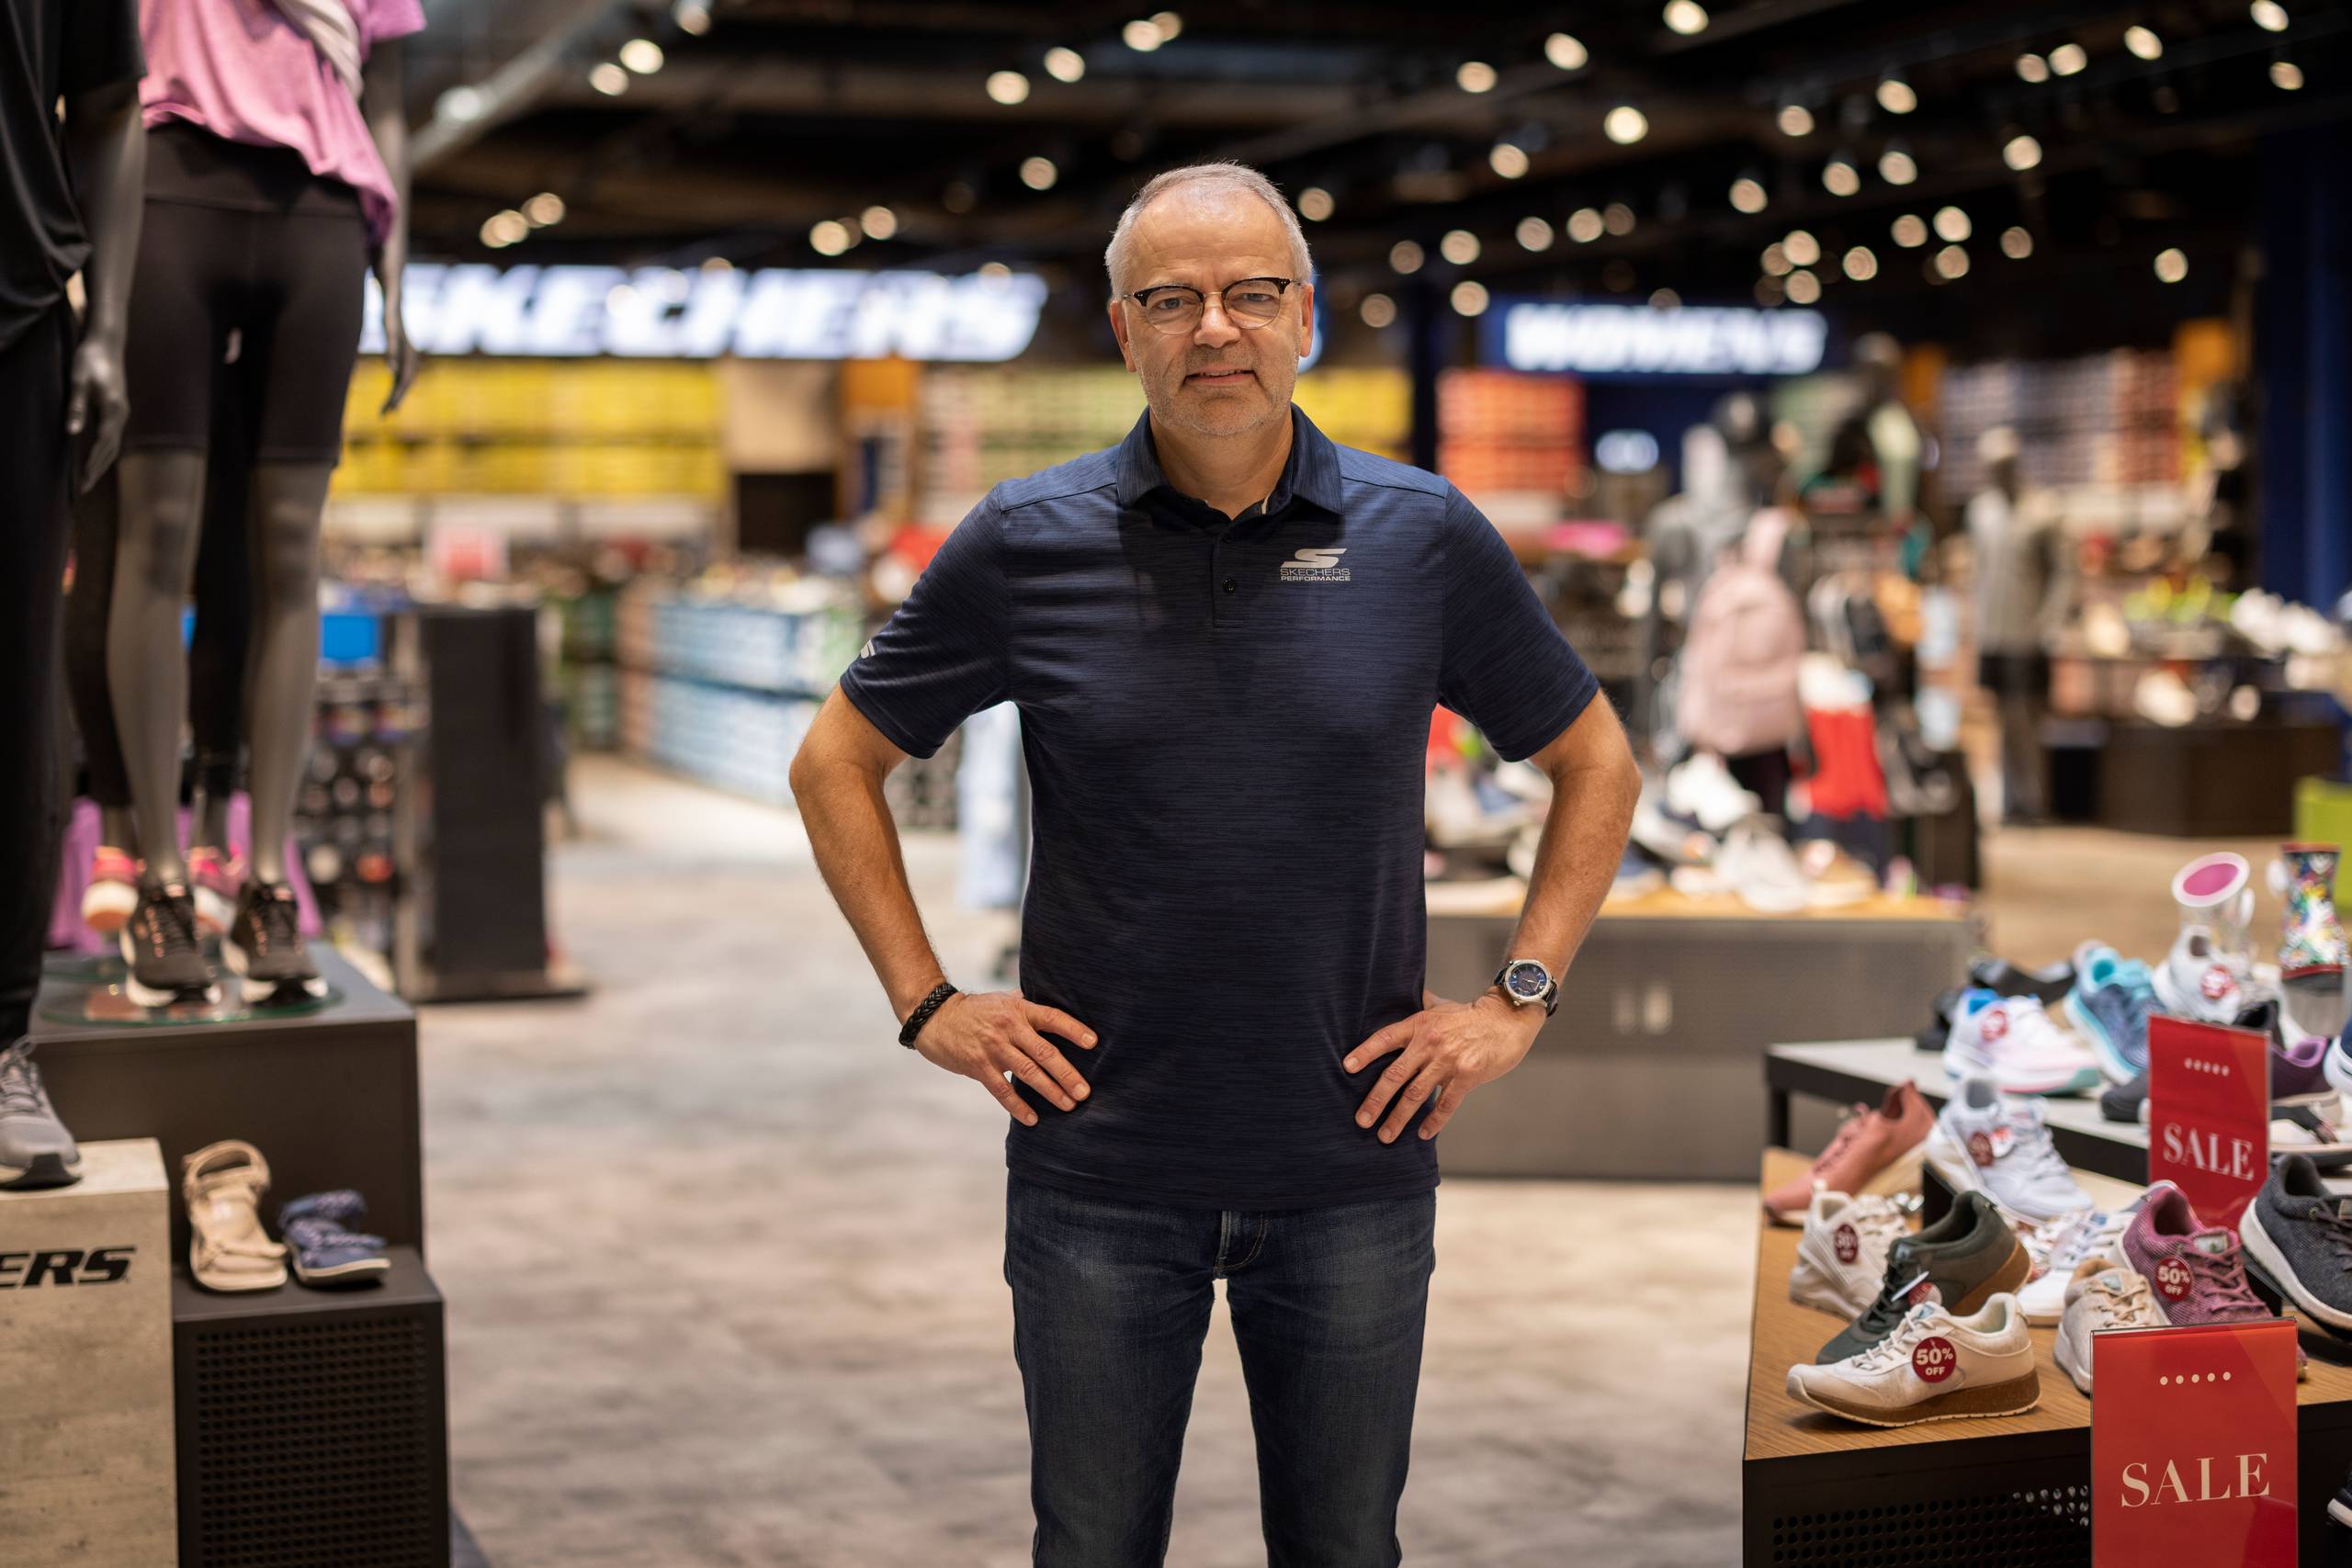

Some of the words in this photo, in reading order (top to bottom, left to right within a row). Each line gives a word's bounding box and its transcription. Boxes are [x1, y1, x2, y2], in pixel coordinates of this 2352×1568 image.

[358, 263, 1049, 361] SKECHERS
[1280, 568, 1351, 576] SKECHERS
[2162, 1122, 2255, 1181] SALE
[0, 1245, 137, 1288] ERS
[2157, 1265, 2190, 1284] 50%
[2165, 1283, 2184, 1296] OFF
[1916, 1348, 1954, 1366] 50%
[1925, 1366, 1946, 1376] OFF
[2120, 1452, 2271, 1508] SALE
